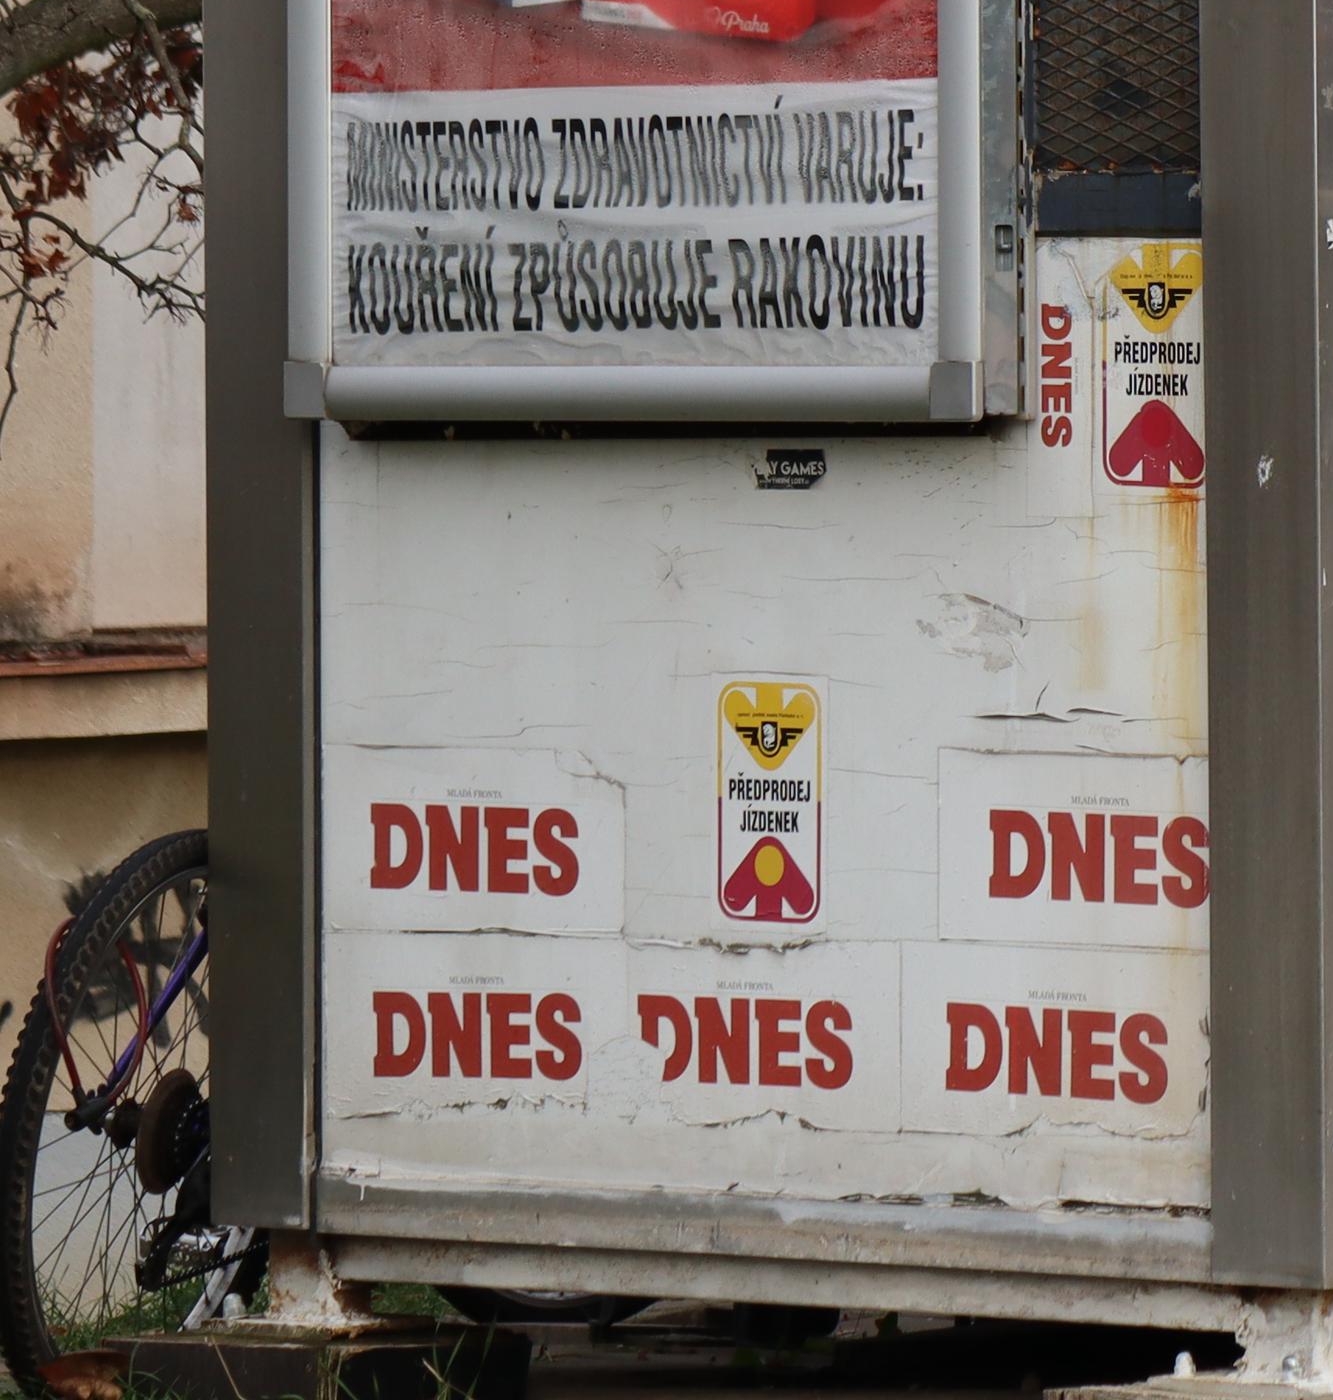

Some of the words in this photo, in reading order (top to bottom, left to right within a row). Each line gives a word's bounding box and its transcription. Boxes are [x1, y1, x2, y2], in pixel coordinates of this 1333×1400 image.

[721, 9, 770, 34] Praha
[347, 116, 545, 212] MINISTERSTVO
[551, 94, 784, 209] ZDRAVOTNICTVÍ
[794, 107, 925, 205] VARUJE:
[348, 225, 499, 335] KOUŘENÍ
[510, 218, 722, 332] ZPŮSOBUJE
[729, 233, 925, 331] RAKOVINU
[1114, 335, 1201, 365] PŘEDPRODEJ
[1041, 303, 1073, 448] DNES
[1126, 368, 1189, 396] JÍZDENEK
[780, 460, 825, 476] GAMES
[447, 787, 471, 798] MLADÁ
[473, 789, 502, 799] FRONTA
[728, 771, 811, 802] PŘEDPRODEJ
[1071, 795, 1097, 805] MLADÁ
[1099, 797, 1130, 807] FRONTA
[740, 803, 799, 833] JÍZDENEK
[370, 803, 580, 896] DNES
[990, 810, 1210, 909] DNES
[448, 975, 473, 985] MLADÁ
[476, 975, 504, 985] FRONTA
[717, 979, 742, 990] MLADÁ
[744, 982, 774, 991] FRONTA
[1028, 989, 1055, 1000] MLADÁ
[1056, 992, 1087, 1002] FRONTA
[373, 992, 582, 1081] DNES
[638, 995, 854, 1090] DNES
[946, 1002, 1169, 1105] DNES
